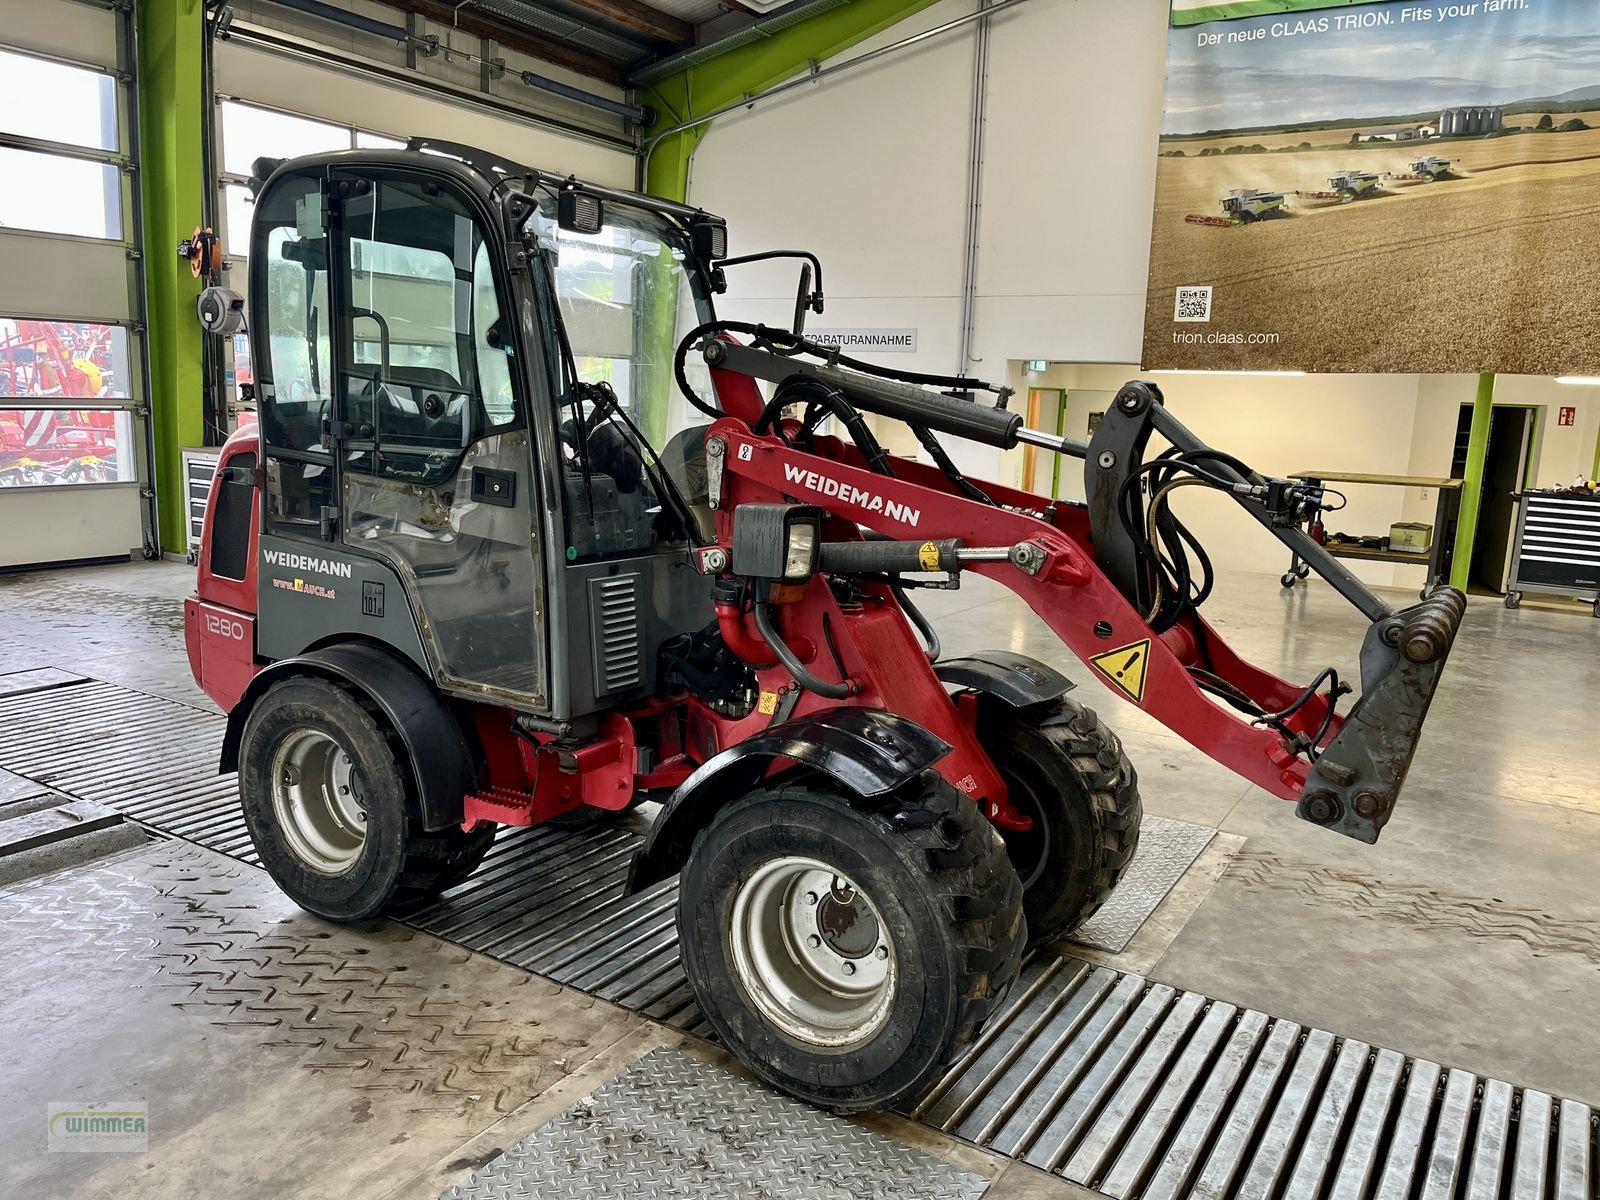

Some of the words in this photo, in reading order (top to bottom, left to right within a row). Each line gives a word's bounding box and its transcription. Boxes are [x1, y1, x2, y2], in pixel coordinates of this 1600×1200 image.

[1197, 32, 1224, 47] Der
[1227, 28, 1267, 43] neue
[1270, 17, 1329, 38] CLAAS
[1334, 11, 1395, 31] TRION.
[1400, 8, 1433, 23] Fits
[1437, 3, 1479, 22] your
[804, 334, 912, 346] PARATURANNAHME
[1172, 331, 1280, 344] trion.claas.com
[783, 462, 921, 527] WEIDEMANN
[263, 548, 352, 579] WEIDEMANN
[364, 595, 377, 615] 101
[205, 613, 244, 641] 1280
